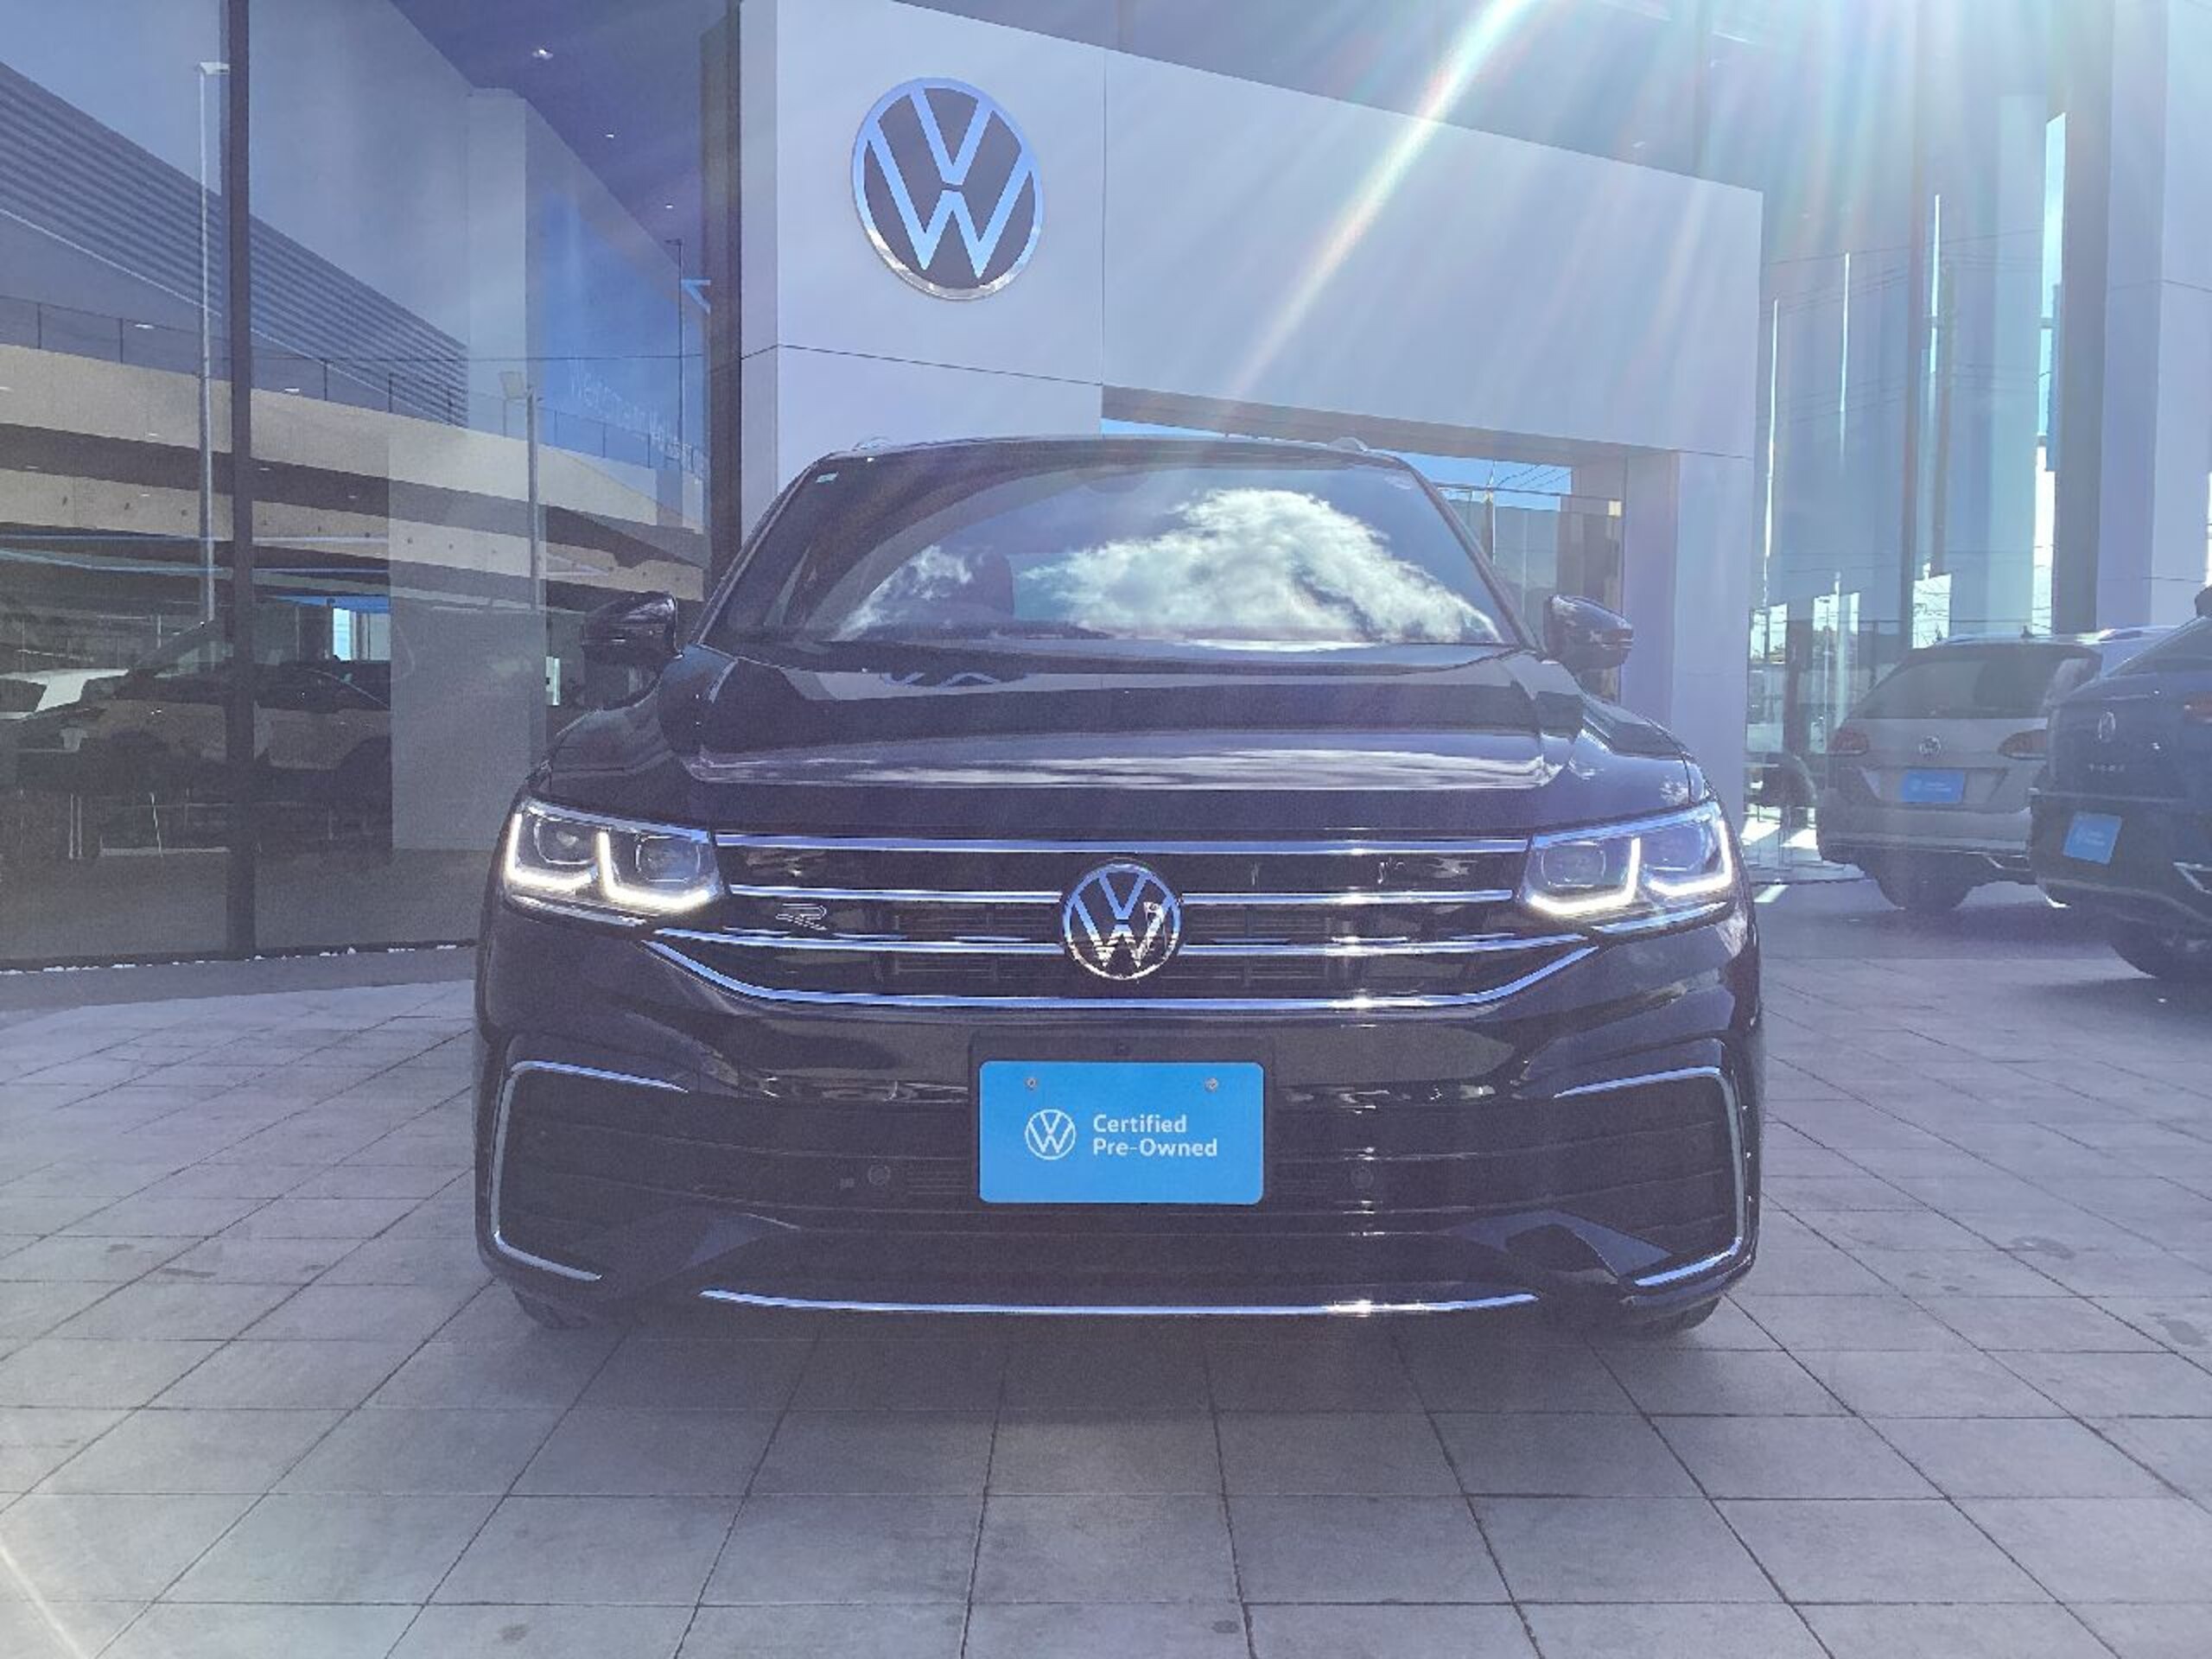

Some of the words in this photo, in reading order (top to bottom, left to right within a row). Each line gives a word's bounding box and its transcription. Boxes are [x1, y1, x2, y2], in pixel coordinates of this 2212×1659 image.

[859, 81, 1039, 279] VW
[1068, 868, 1177, 969] VW
[1027, 1111, 1075, 1155] VW
[1092, 1113, 1187, 1134] Certified
[1092, 1137, 1218, 1157] Pre-Owned
